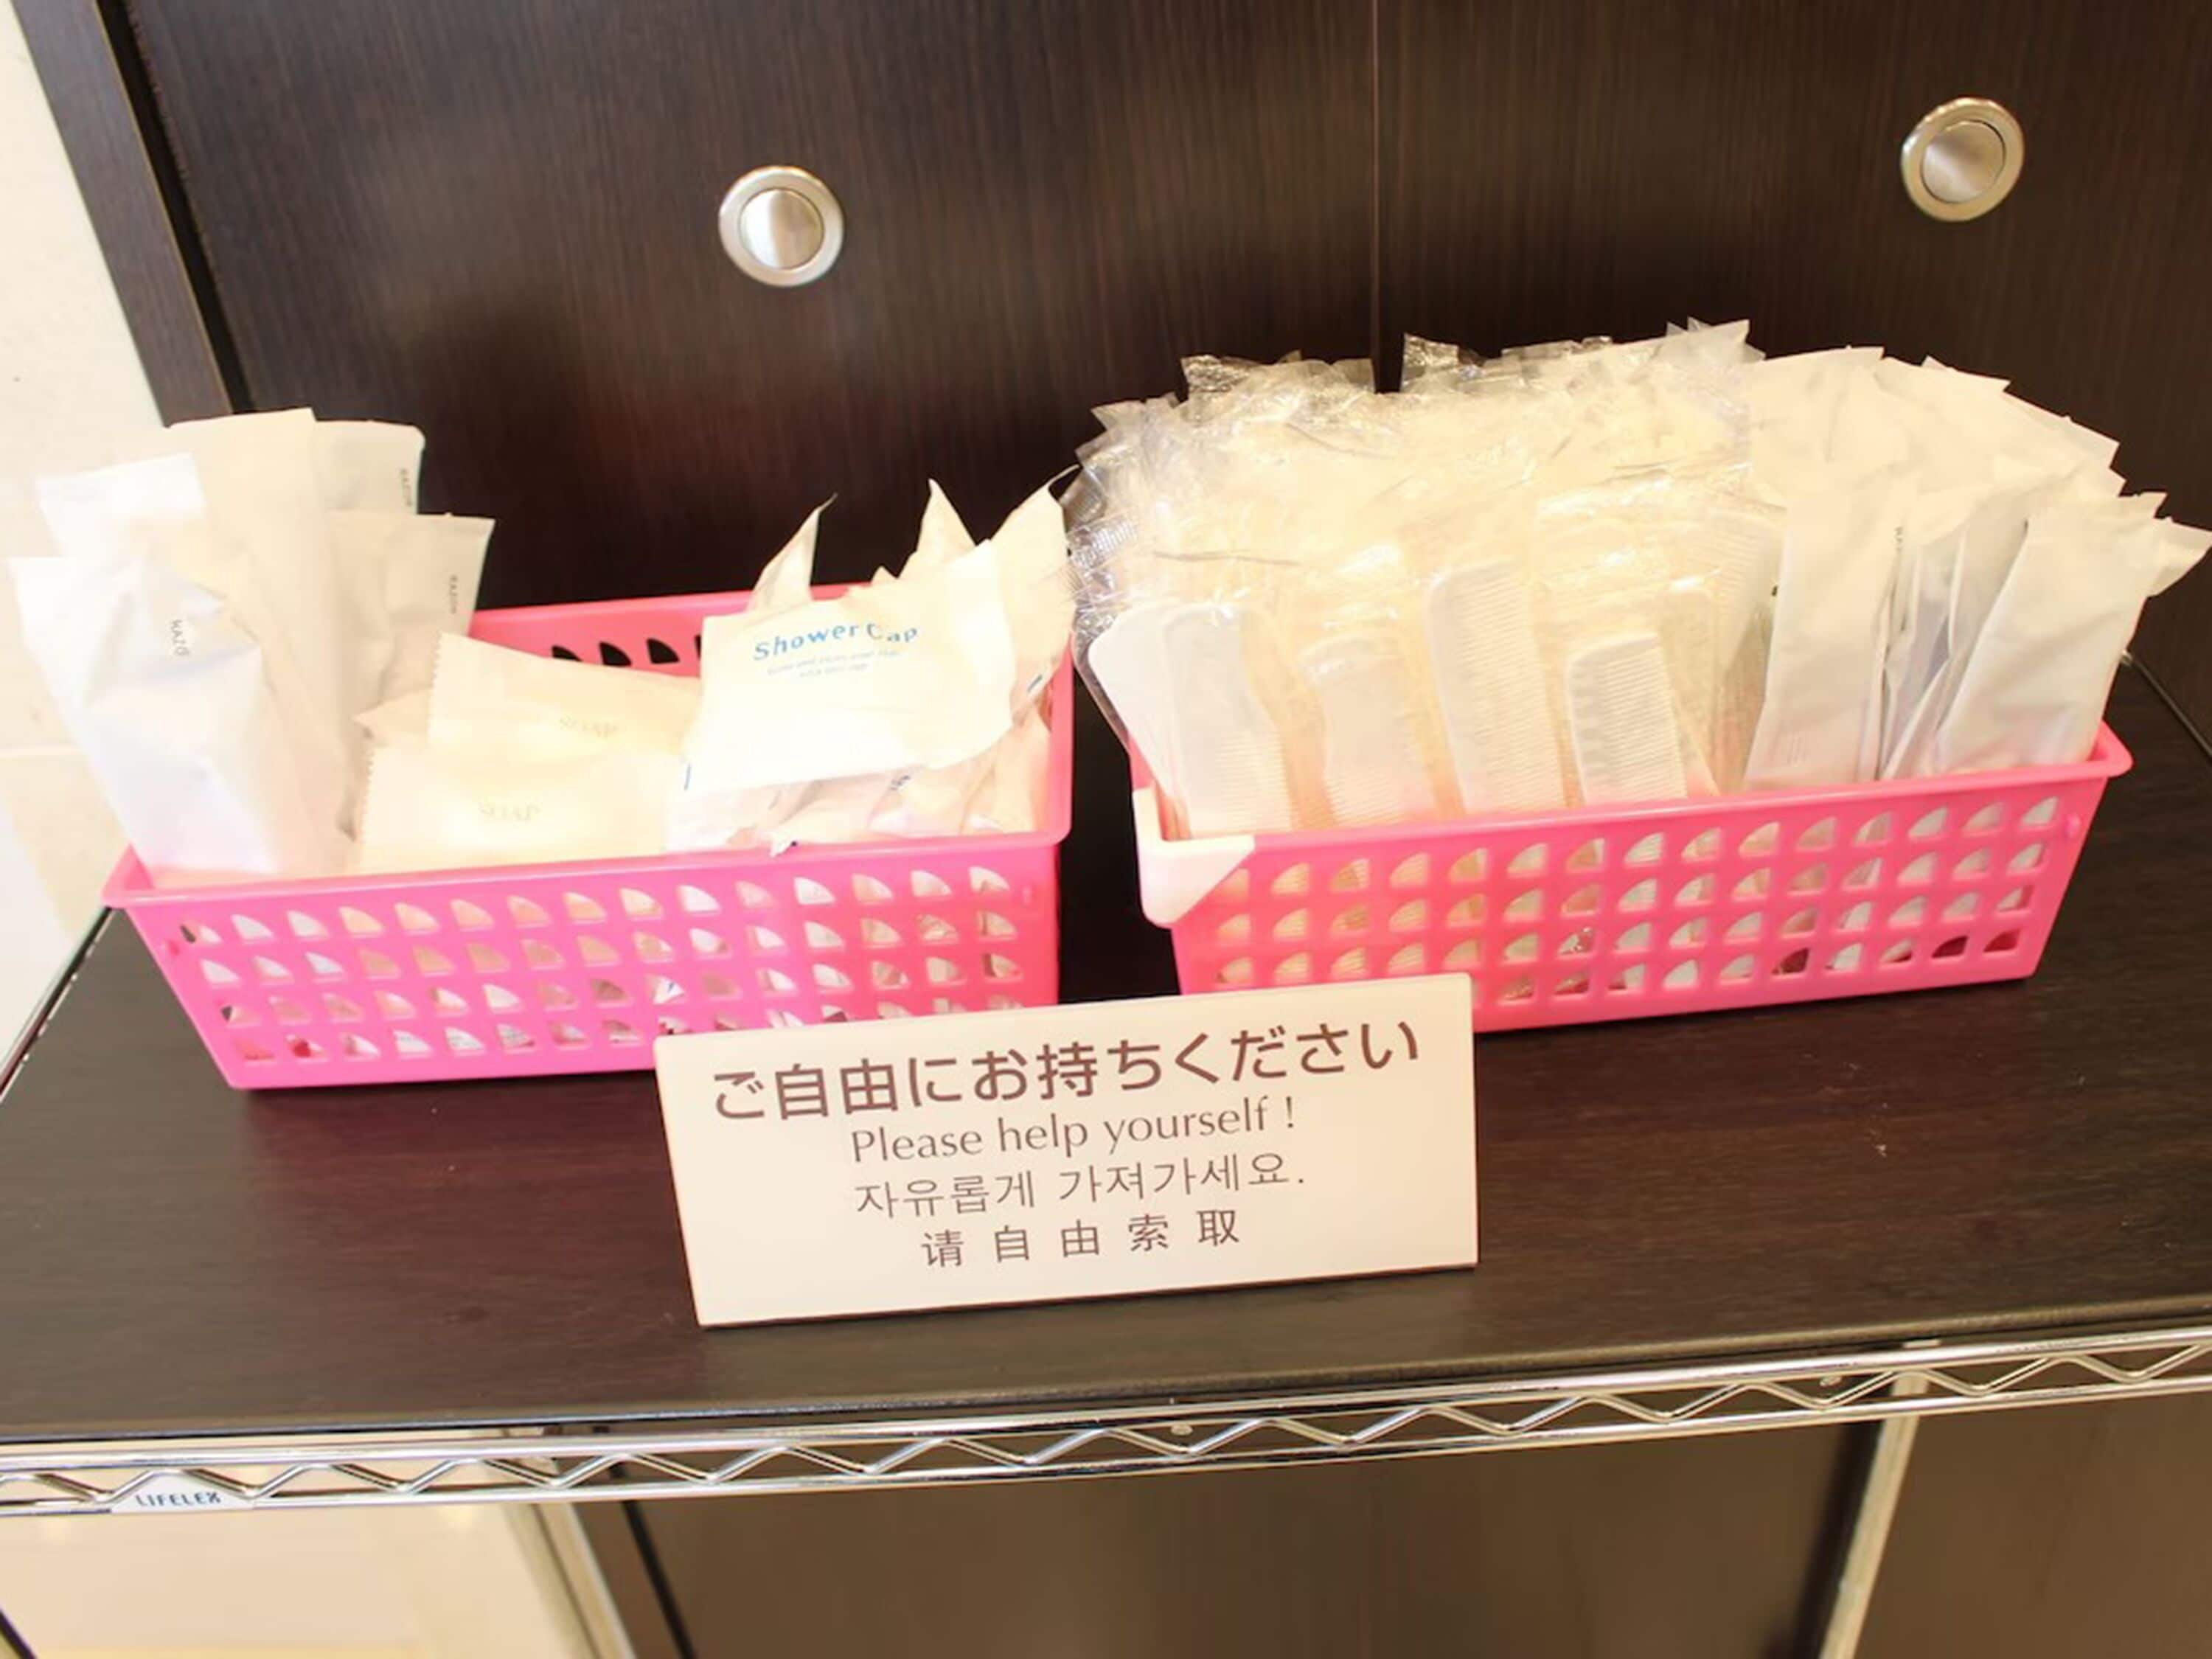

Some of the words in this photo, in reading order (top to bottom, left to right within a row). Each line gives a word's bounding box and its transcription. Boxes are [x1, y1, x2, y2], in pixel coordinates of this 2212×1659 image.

[752, 624, 859, 661] Shower
[866, 622, 919, 643] Cap
[712, 1020, 1420, 1121] ご自由にお持ちください
[851, 1126, 983, 1163] Please
[997, 1112, 1088, 1158] help
[855, 1170, 1035, 1220] 자유롭게
[1058, 1152, 1306, 1203] 가져가세요.
[136, 1491, 221, 1507] LIFELEX
